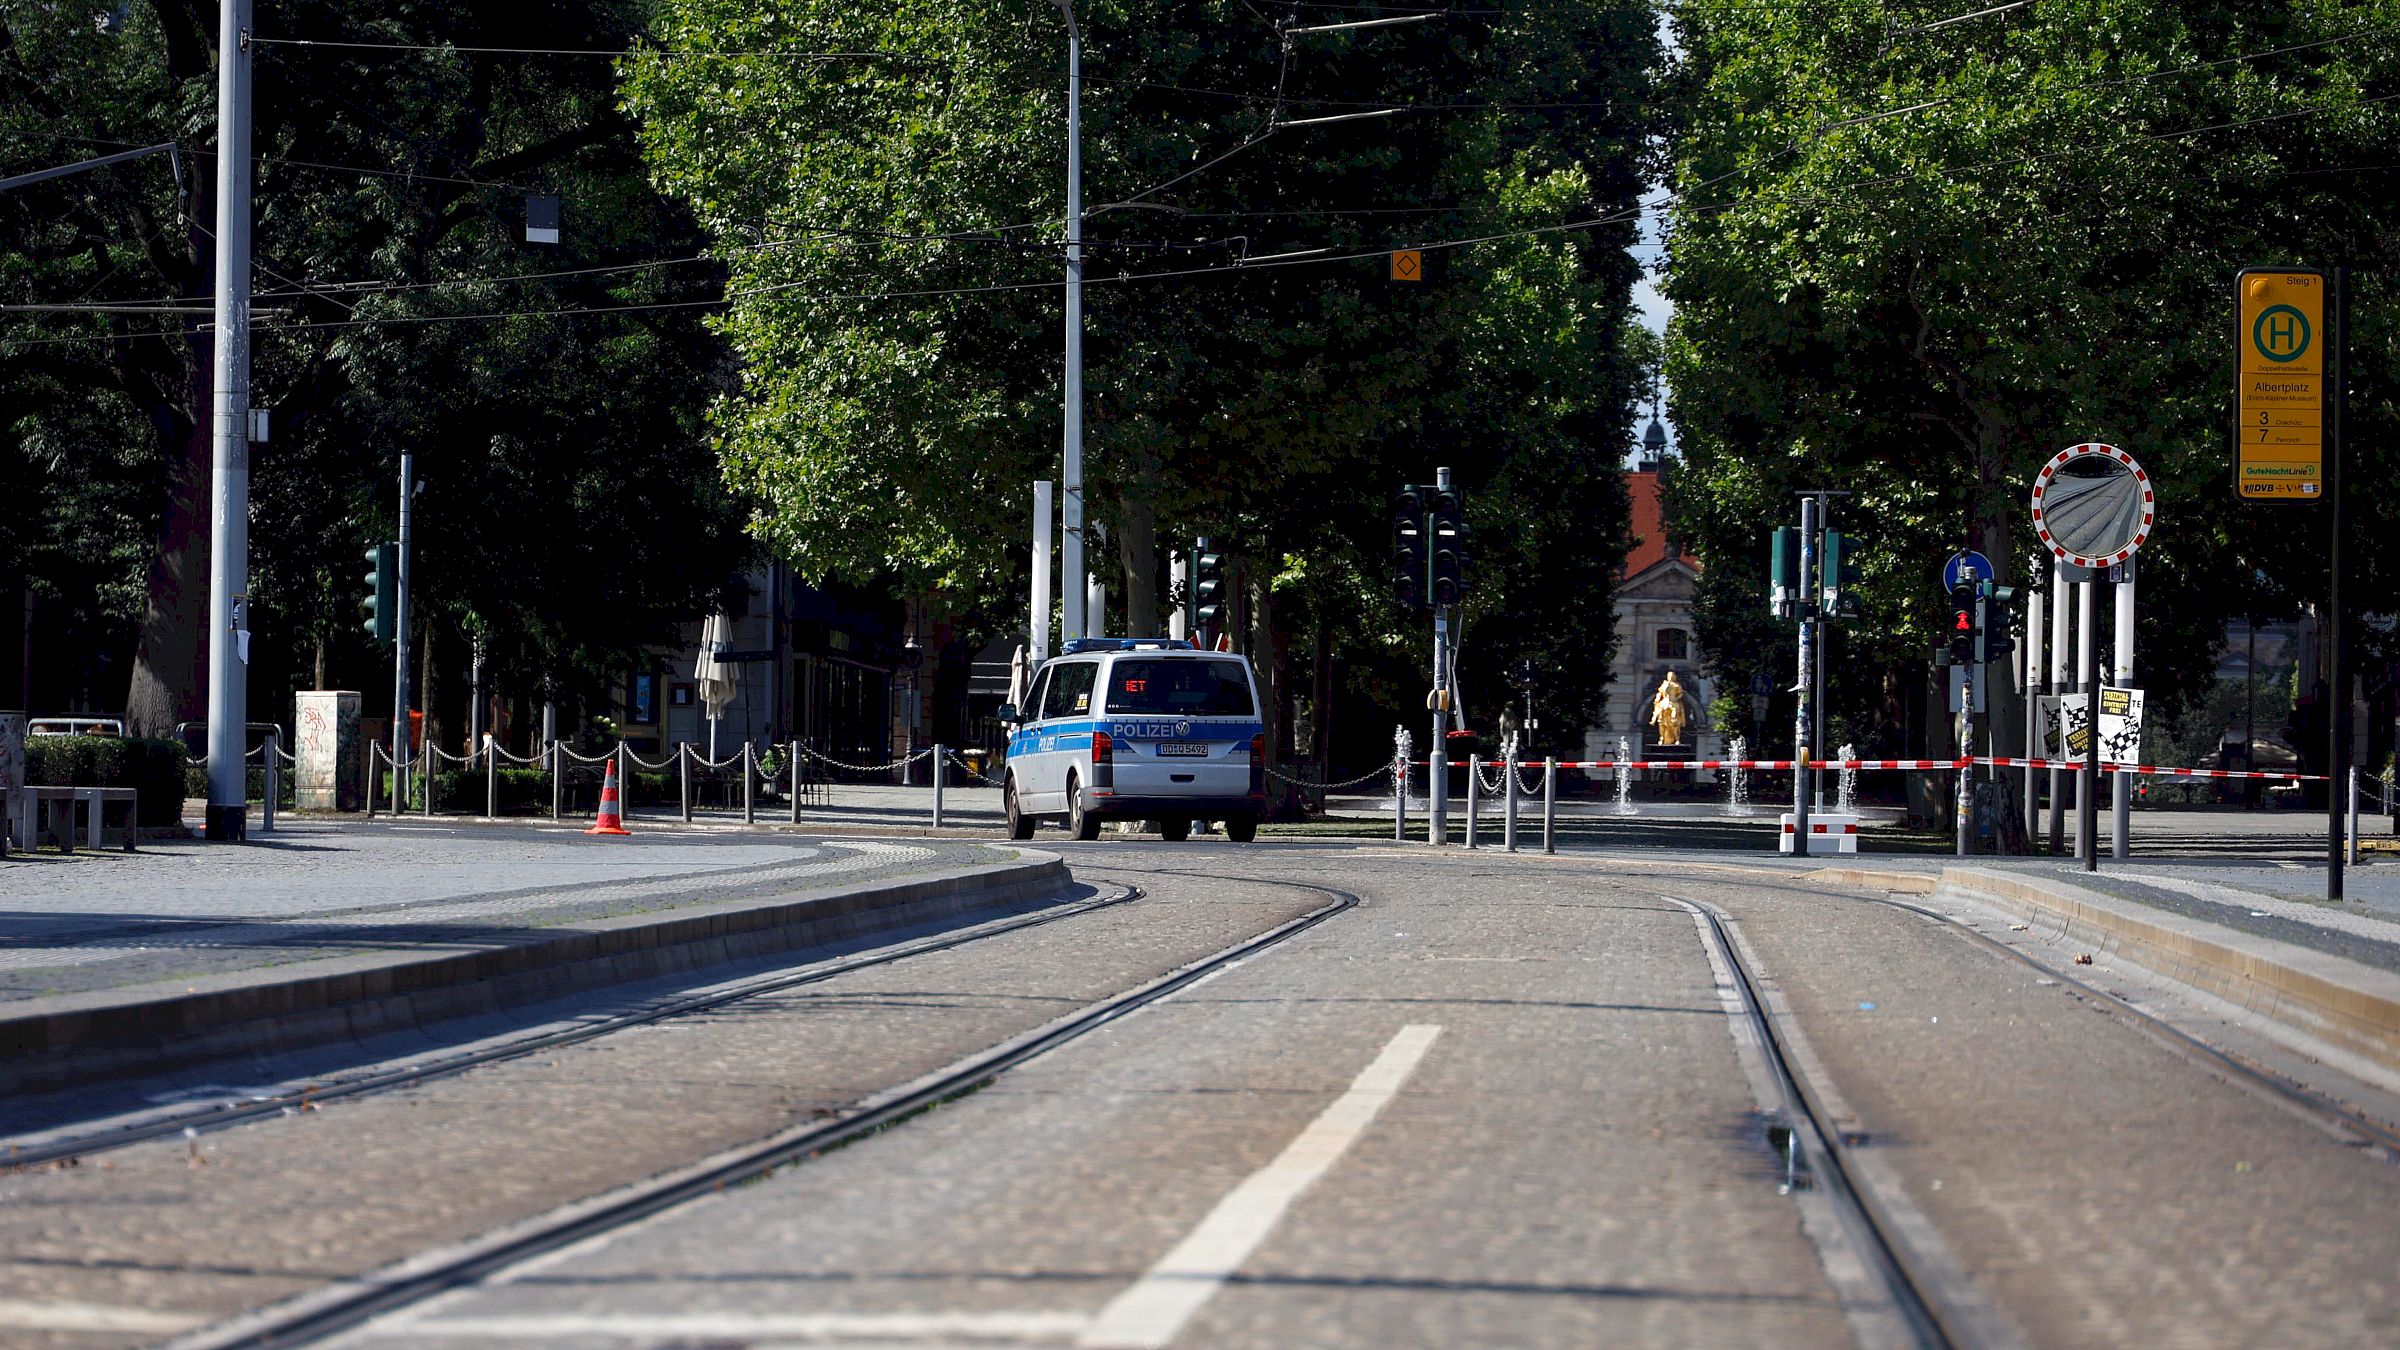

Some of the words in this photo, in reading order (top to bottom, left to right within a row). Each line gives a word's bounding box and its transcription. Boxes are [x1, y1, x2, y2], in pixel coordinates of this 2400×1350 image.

[2286, 276, 2310, 287] Steig
[2313, 277, 2317, 285] 1
[2270, 317, 2294, 350] H
[2254, 382, 2309, 394] Albertplatz
[2259, 411, 2269, 425] 3
[2259, 428, 2269, 443] 7
[2246, 466, 2308, 476] GuteNachtLinie
[2254, 484, 2274, 492] DVB
[1113, 724, 1174, 738] POLIZEI
[1038, 736, 1056, 752] POLIZEI
